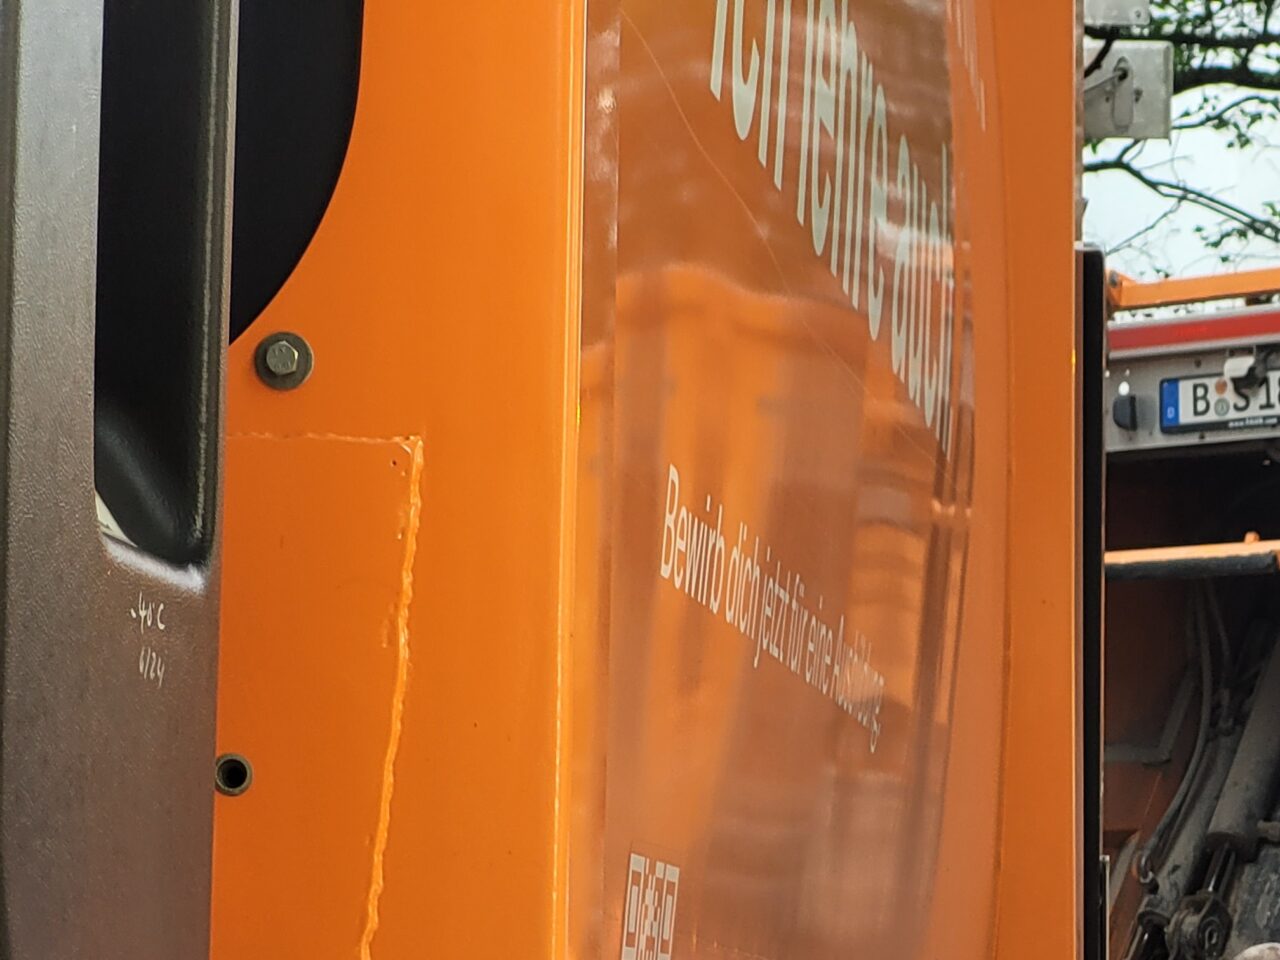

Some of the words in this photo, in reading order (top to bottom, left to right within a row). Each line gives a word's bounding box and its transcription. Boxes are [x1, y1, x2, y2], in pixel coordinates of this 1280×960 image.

[1192, 383, 1210, 416] B
[660, 463, 725, 615] Bewirb
[726, 521, 761, 640] dich
[754, 546, 790, 668] jetzt
[787, 572, 809, 675] für
[805, 595, 834, 695] eine
